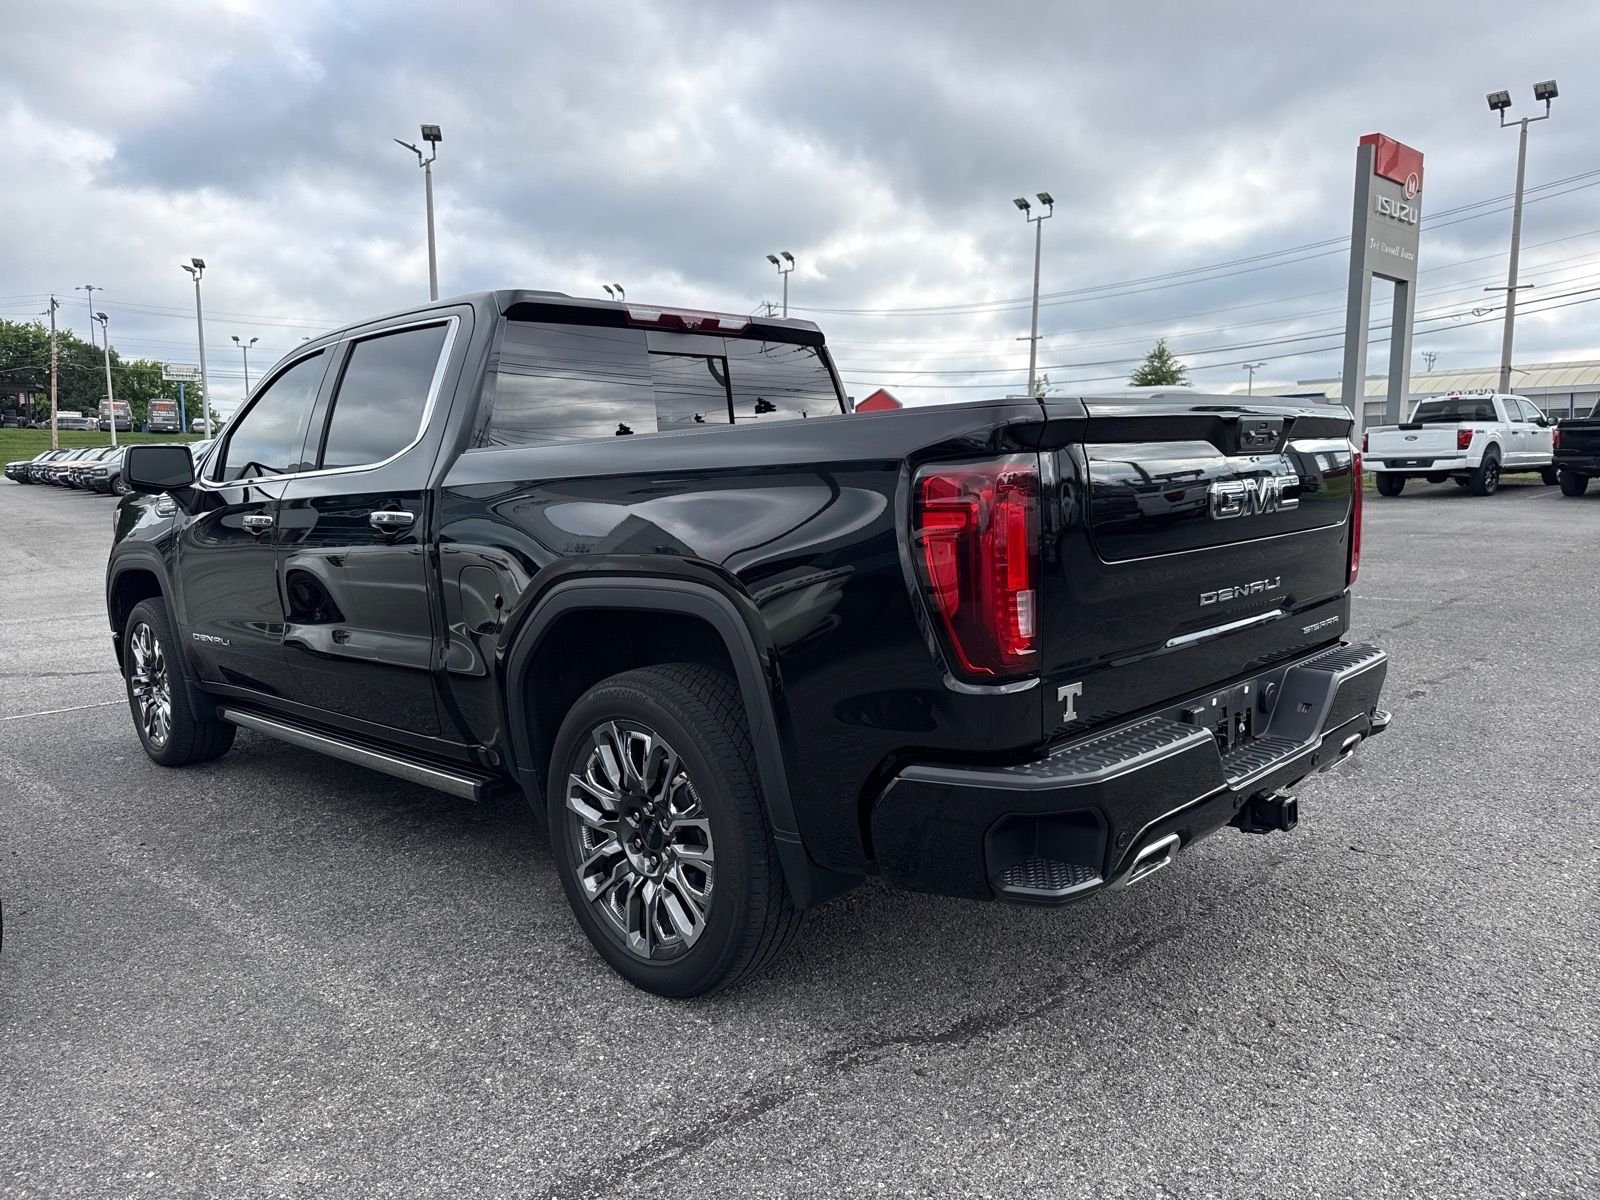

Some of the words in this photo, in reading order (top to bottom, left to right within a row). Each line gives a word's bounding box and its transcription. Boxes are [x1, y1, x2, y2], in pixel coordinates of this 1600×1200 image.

[1376, 195, 1418, 224] ISUZU
[1206, 475, 1299, 520] GMC
[1200, 576, 1281, 606] DENALI
[192, 632, 230, 646] DENALI
[1302, 615, 1339, 634] SIERRA
[1057, 681, 1082, 722] T
